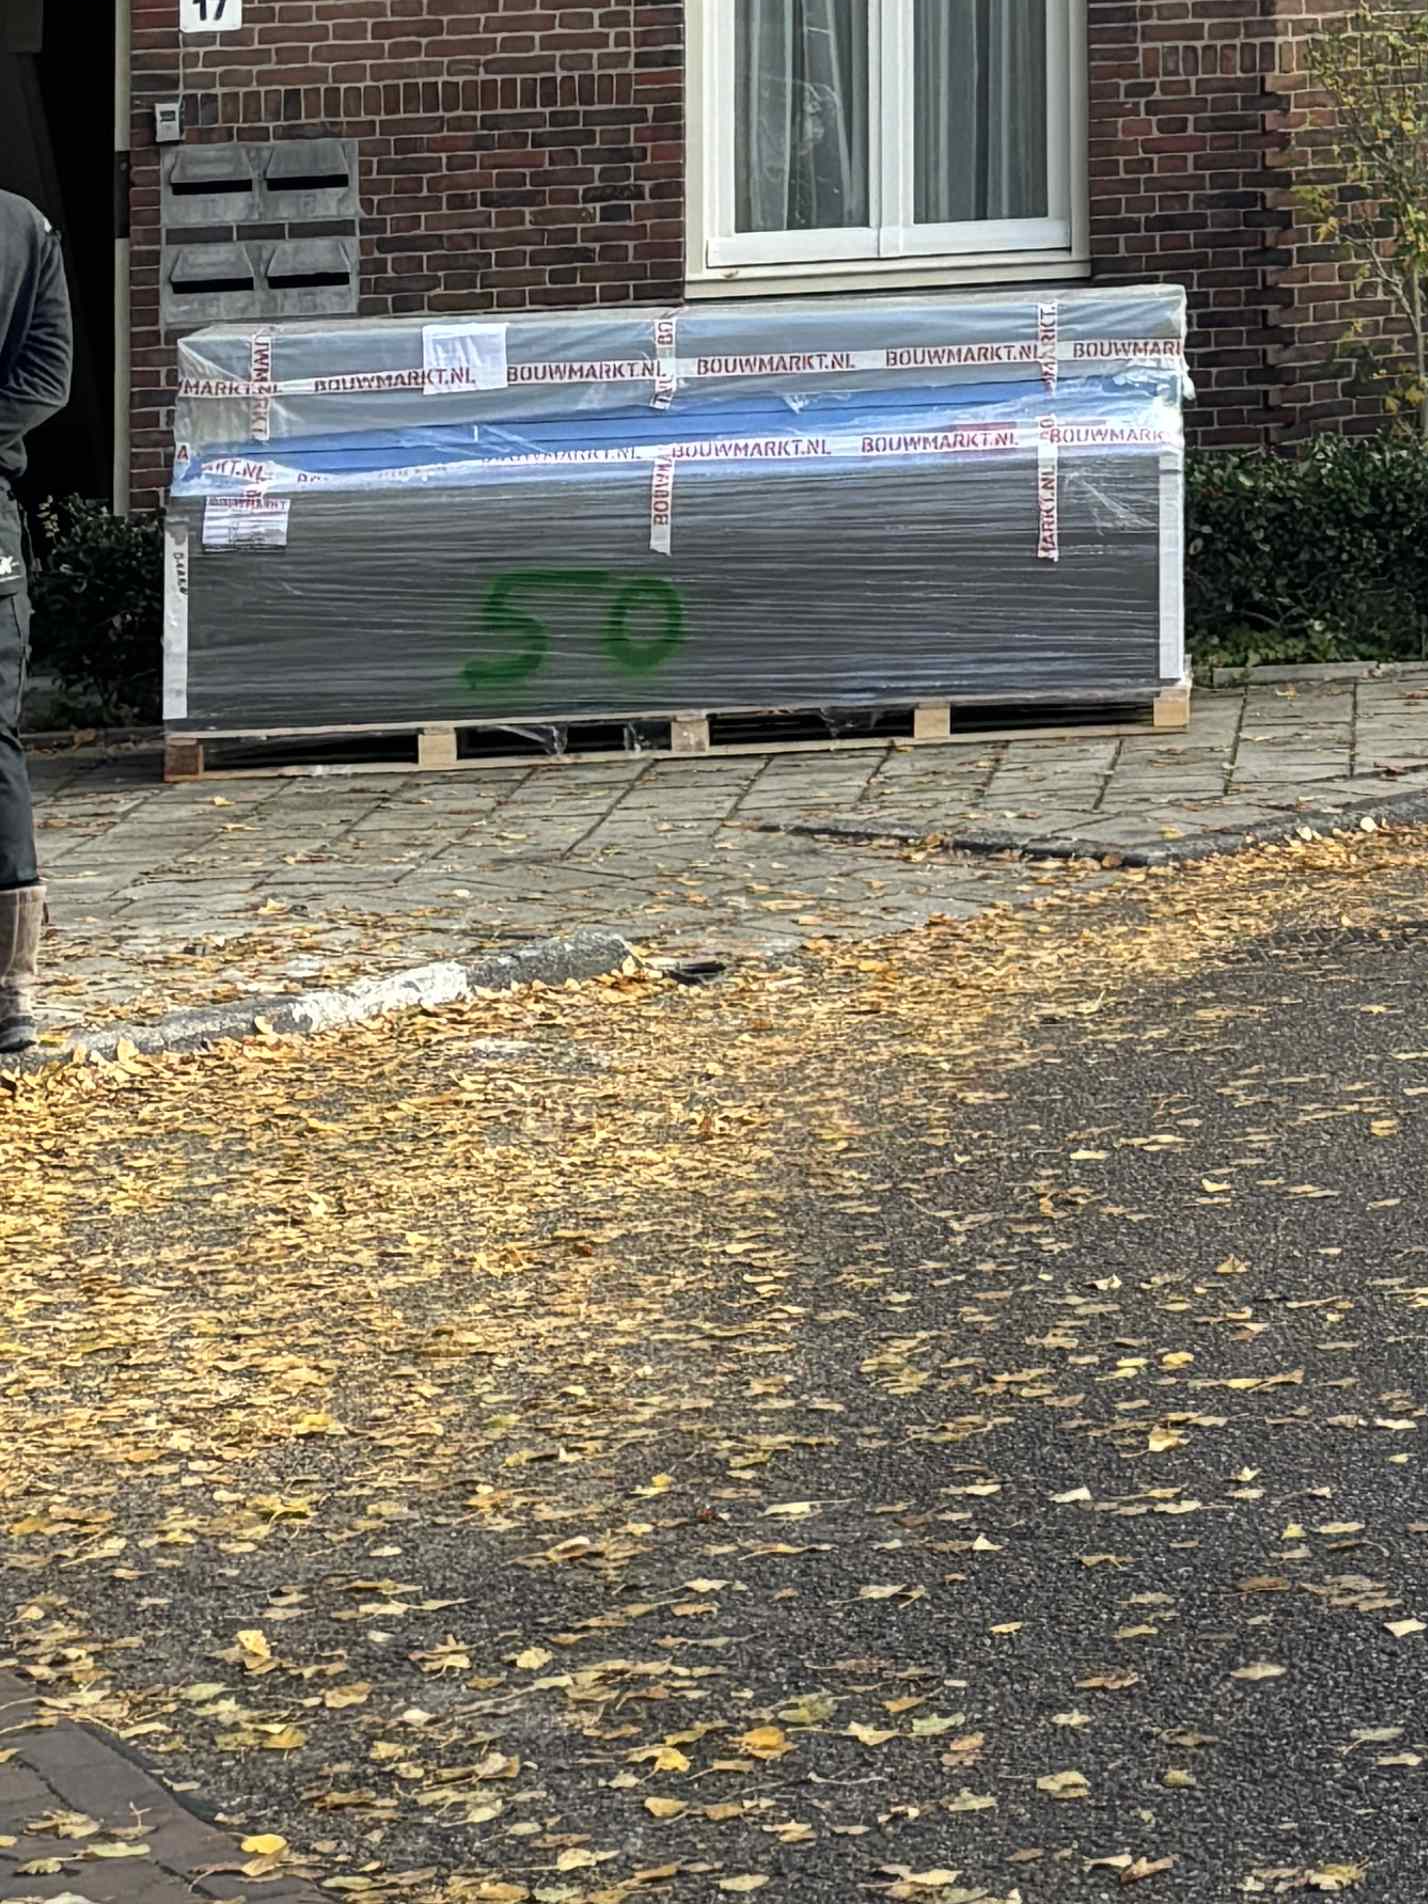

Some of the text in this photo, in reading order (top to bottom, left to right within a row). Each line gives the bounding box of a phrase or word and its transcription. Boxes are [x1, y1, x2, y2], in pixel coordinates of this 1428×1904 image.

[314, 367, 476, 392] BOUWMARKT.NL
[507, 360, 666, 383] BOUWMARKT.NL
[697, 353, 855, 375] BOUWMARKT.NL
[886, 343, 1042, 366] BOUWMARKT.NL
[672, 439, 832, 459] BOUWMARKT.NL
[862, 432, 1018, 453] BOUWMARKT.NL
[460, 568, 686, 688] 50
